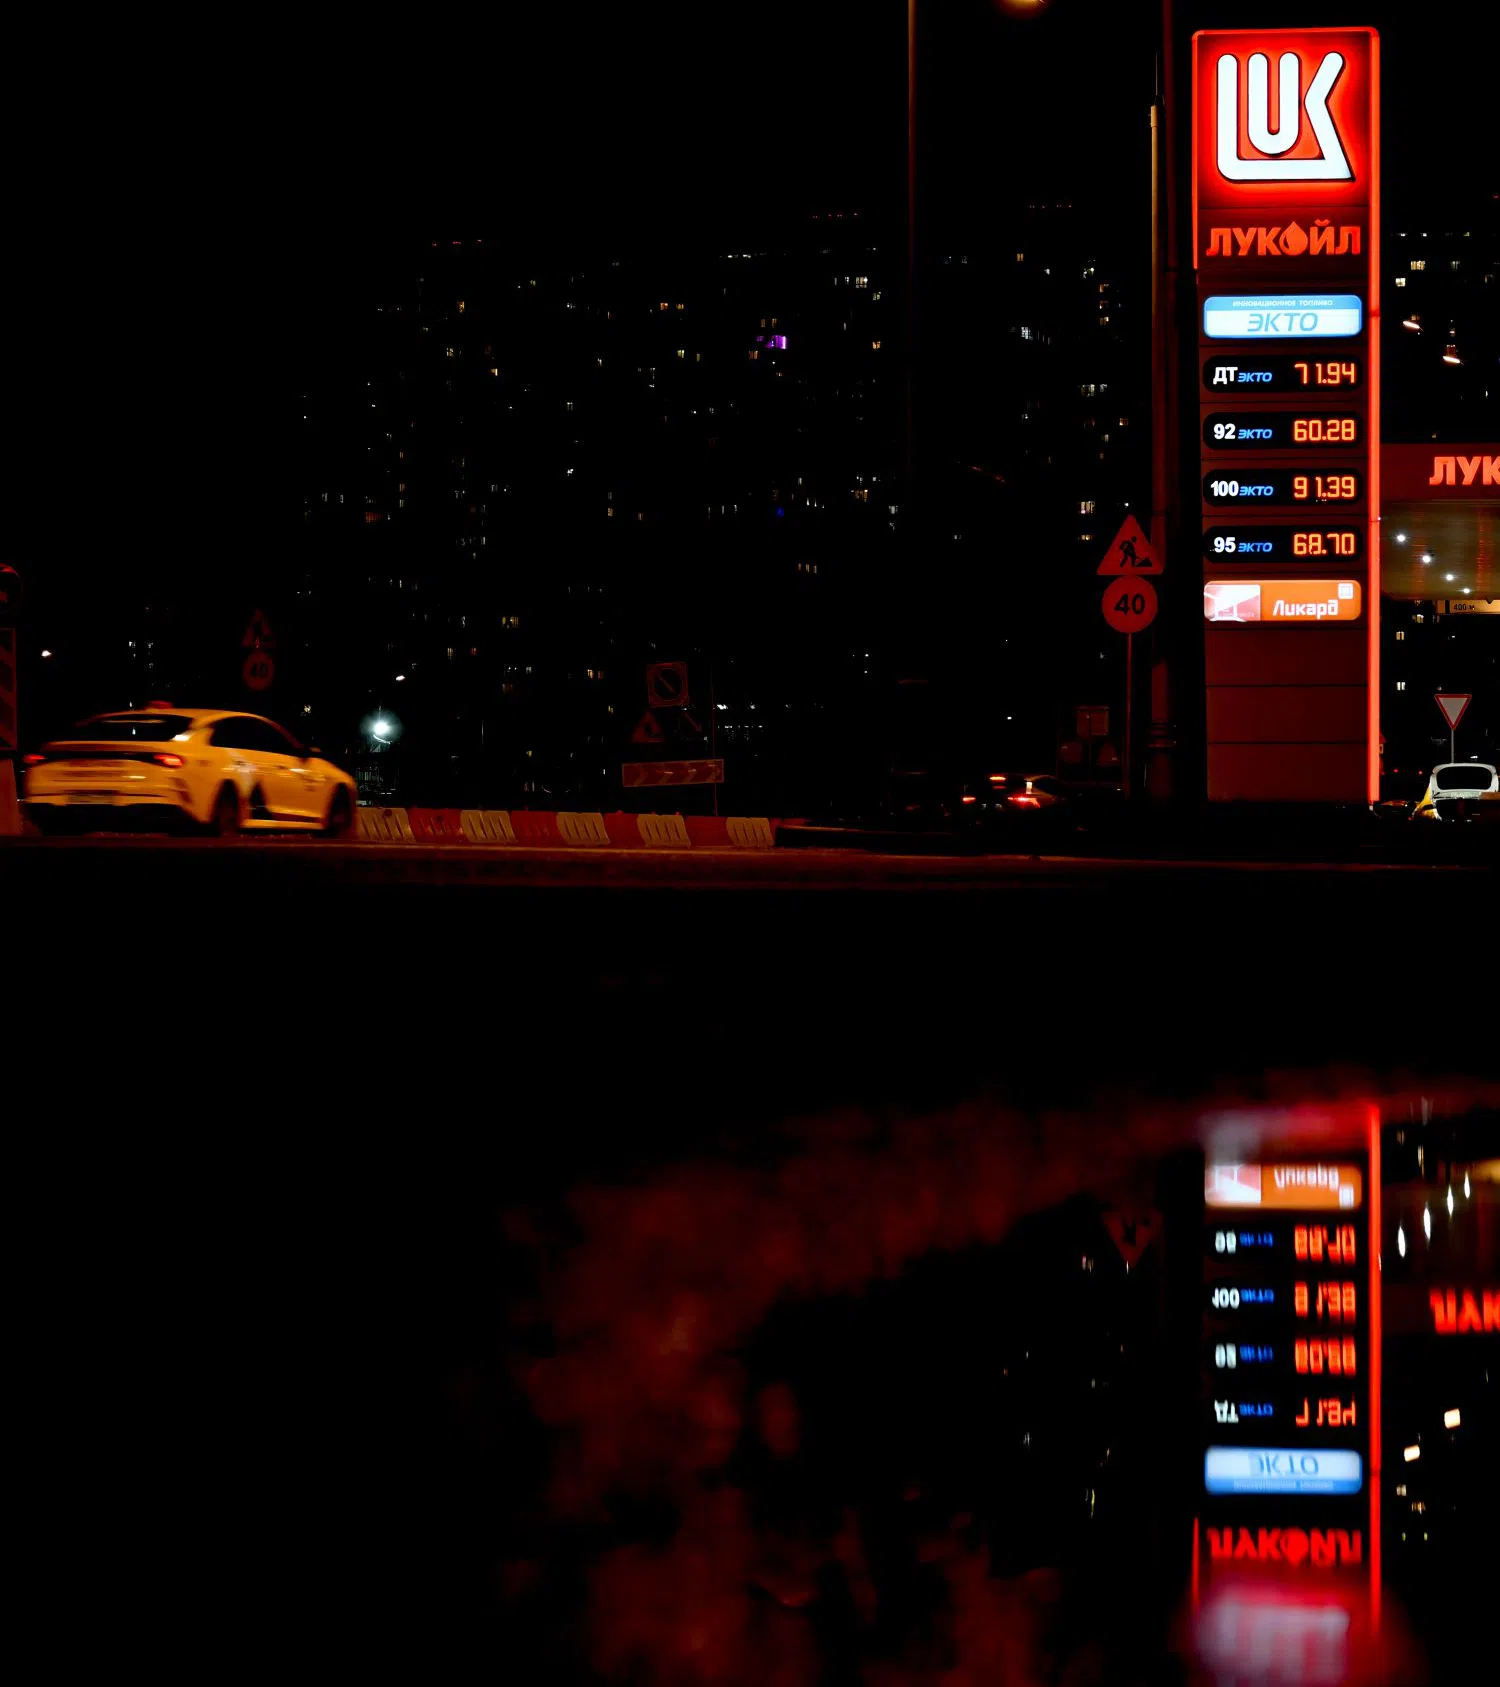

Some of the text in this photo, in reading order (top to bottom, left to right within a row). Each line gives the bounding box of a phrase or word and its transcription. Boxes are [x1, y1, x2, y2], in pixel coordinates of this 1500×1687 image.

[1206, 219, 1361, 256] ЛУКОЙЛ
[1247, 312, 1319, 332] ЭКТО
[1213, 363, 1356, 385] ДТ ЭКТО 71.94
[1213, 420, 1355, 441] 92 ЭКТО 60.28
[1210, 476, 1355, 498] 100 ЭКТО 91.39
[1213, 533, 1355, 555] 95 ЭКТО 68.70
[1114, 593, 1146, 614] 40
[1272, 599, 1339, 619] Ликард
